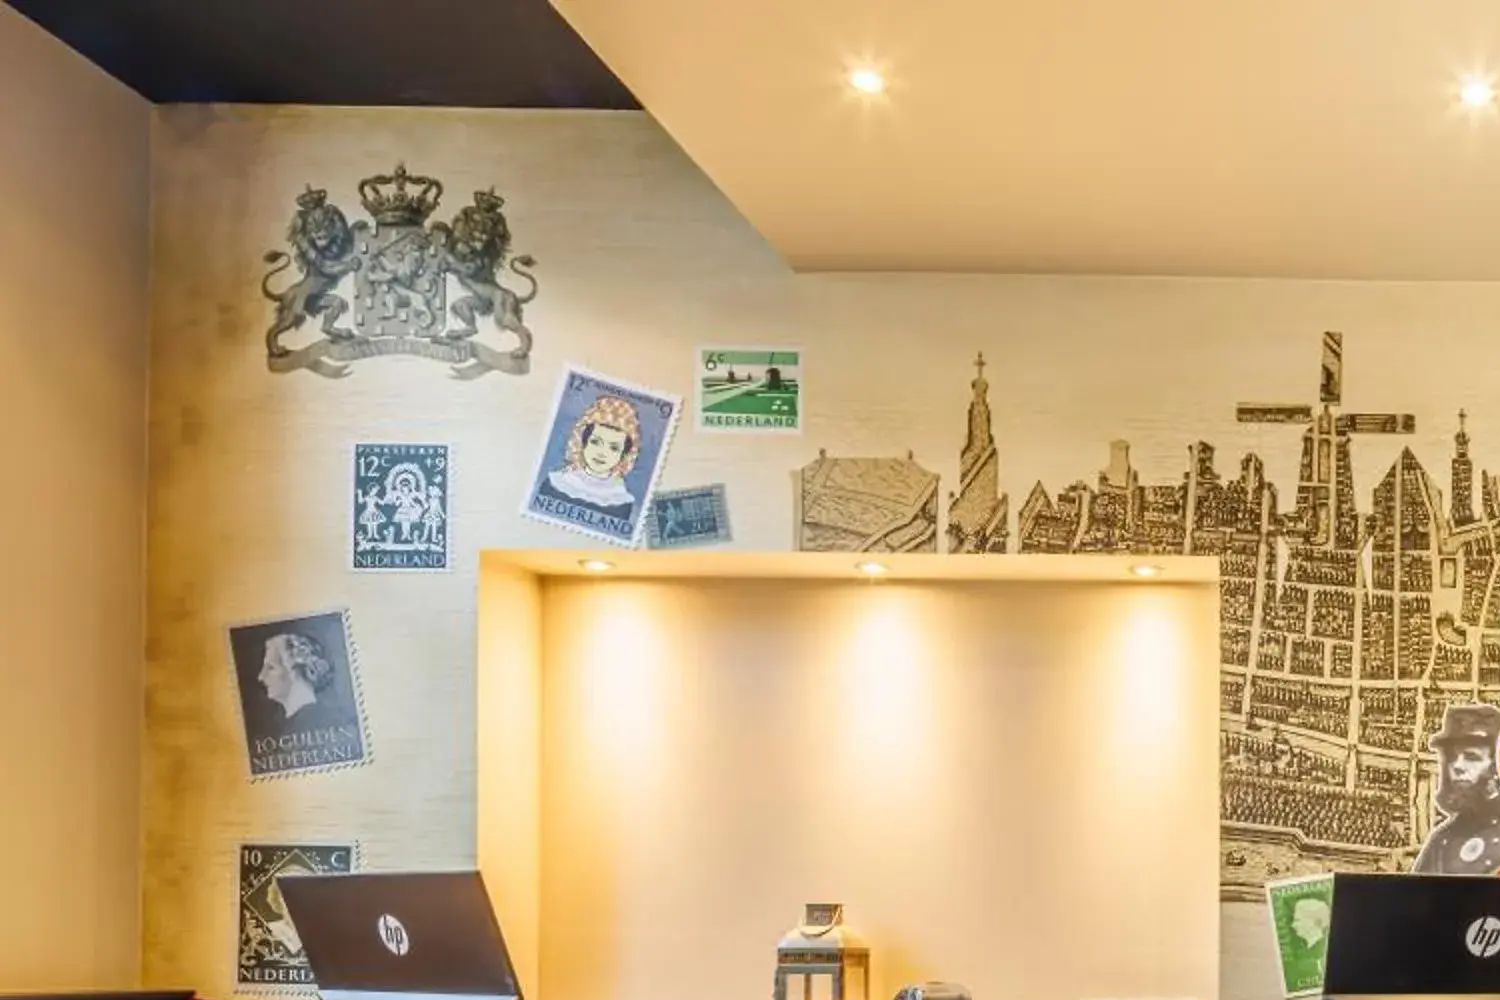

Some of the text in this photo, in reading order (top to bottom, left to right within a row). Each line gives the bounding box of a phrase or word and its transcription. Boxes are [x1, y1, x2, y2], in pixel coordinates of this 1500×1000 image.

[705, 415, 795, 427] NEDERLAND
[533, 495, 634, 536] NEDERLAND
[356, 553, 446, 567] NEDERLAND
[243, 849, 262, 866] 10
[380, 914, 408, 956] hp
[239, 967, 316, 982] NEDERL
